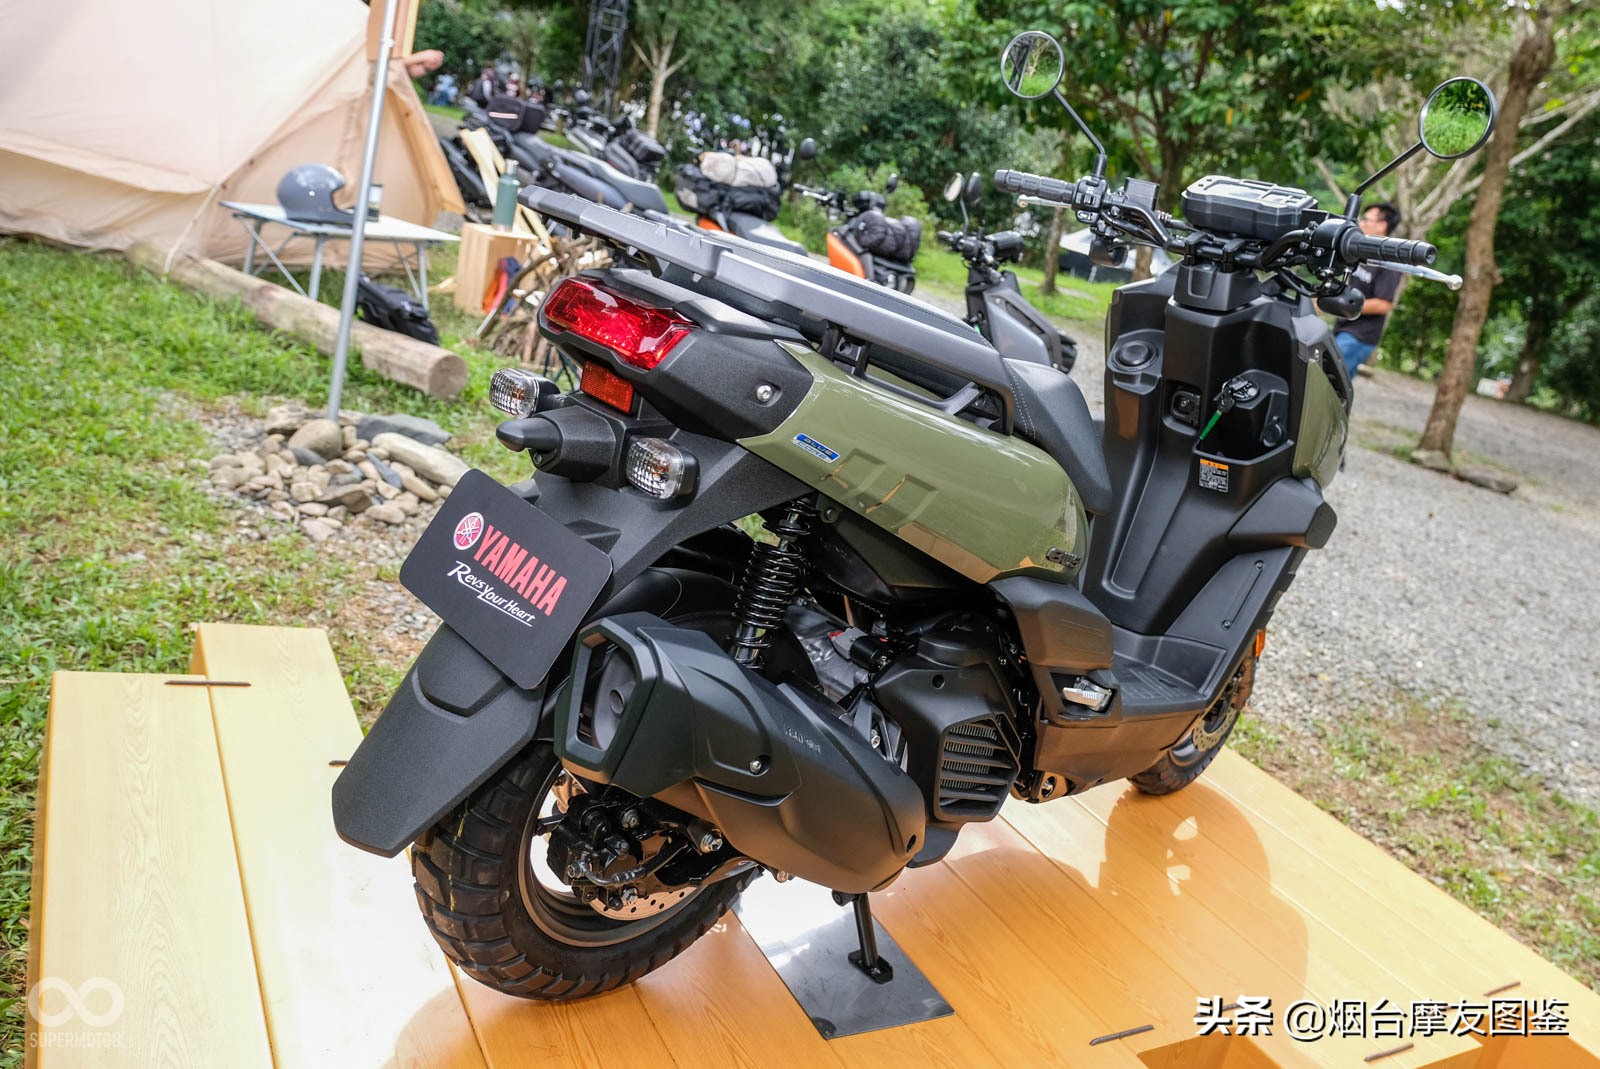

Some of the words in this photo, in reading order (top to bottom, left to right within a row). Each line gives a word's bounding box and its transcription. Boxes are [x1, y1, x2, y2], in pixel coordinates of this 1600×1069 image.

[447, 560, 488, 591] Revs
[479, 581, 508, 604] Your
[504, 599, 536, 622] Heart
[472, 524, 568, 616] YAMAHA
